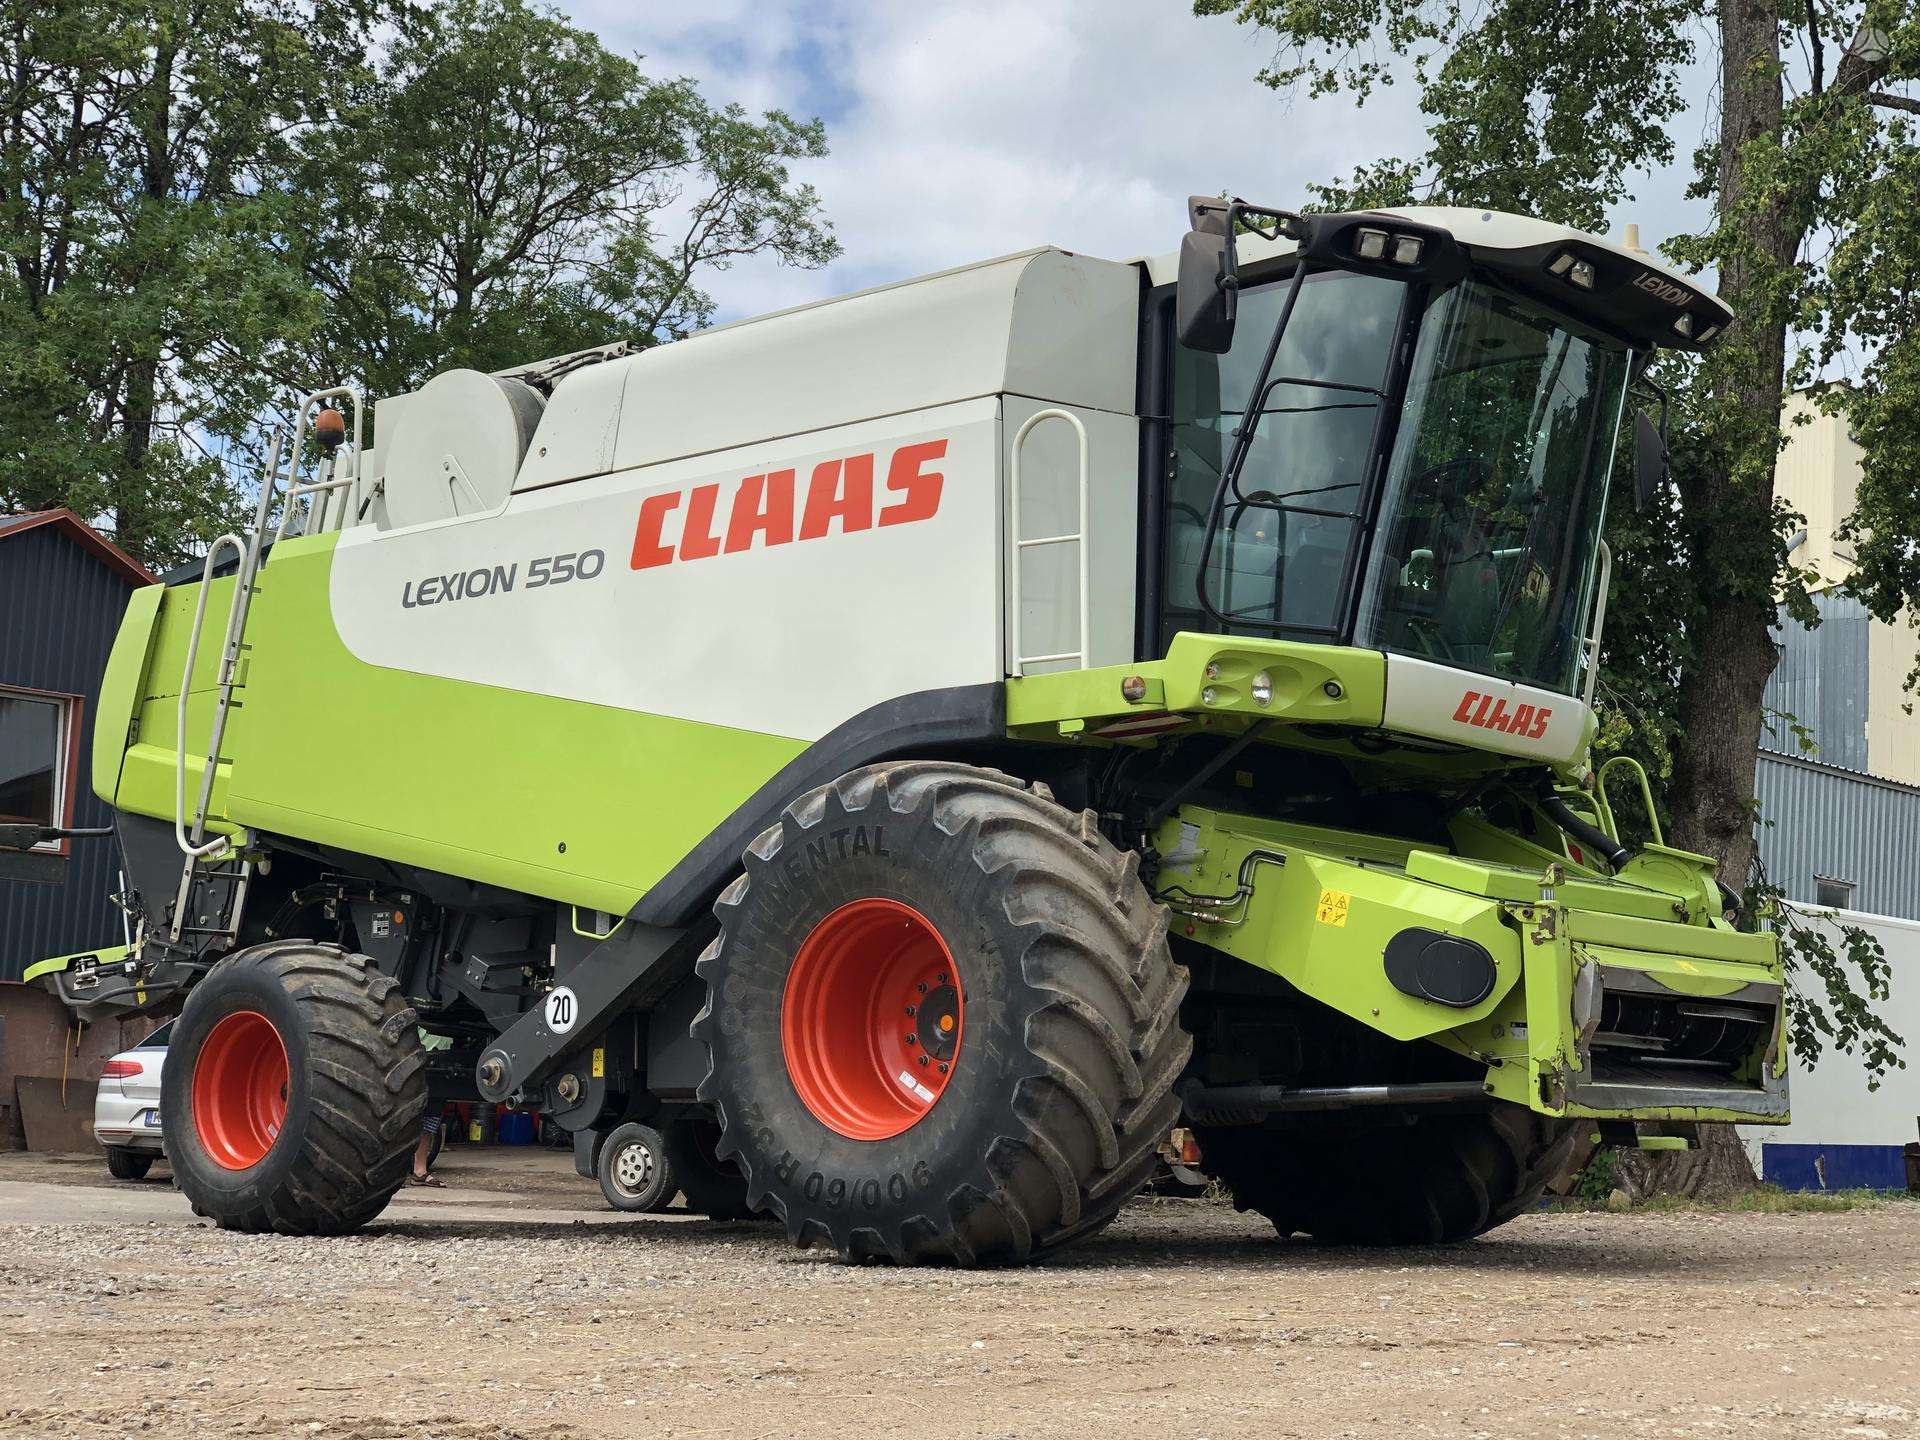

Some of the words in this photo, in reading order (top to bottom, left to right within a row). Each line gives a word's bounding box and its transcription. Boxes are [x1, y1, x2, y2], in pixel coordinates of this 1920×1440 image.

[1632, 271, 1694, 307] LEXION
[630, 438, 948, 571] CLAAS
[401, 562, 518, 609] LEXION
[525, 548, 606, 590] 550
[1452, 691, 1553, 739] CLAAS
[552, 995, 571, 1024] 20
